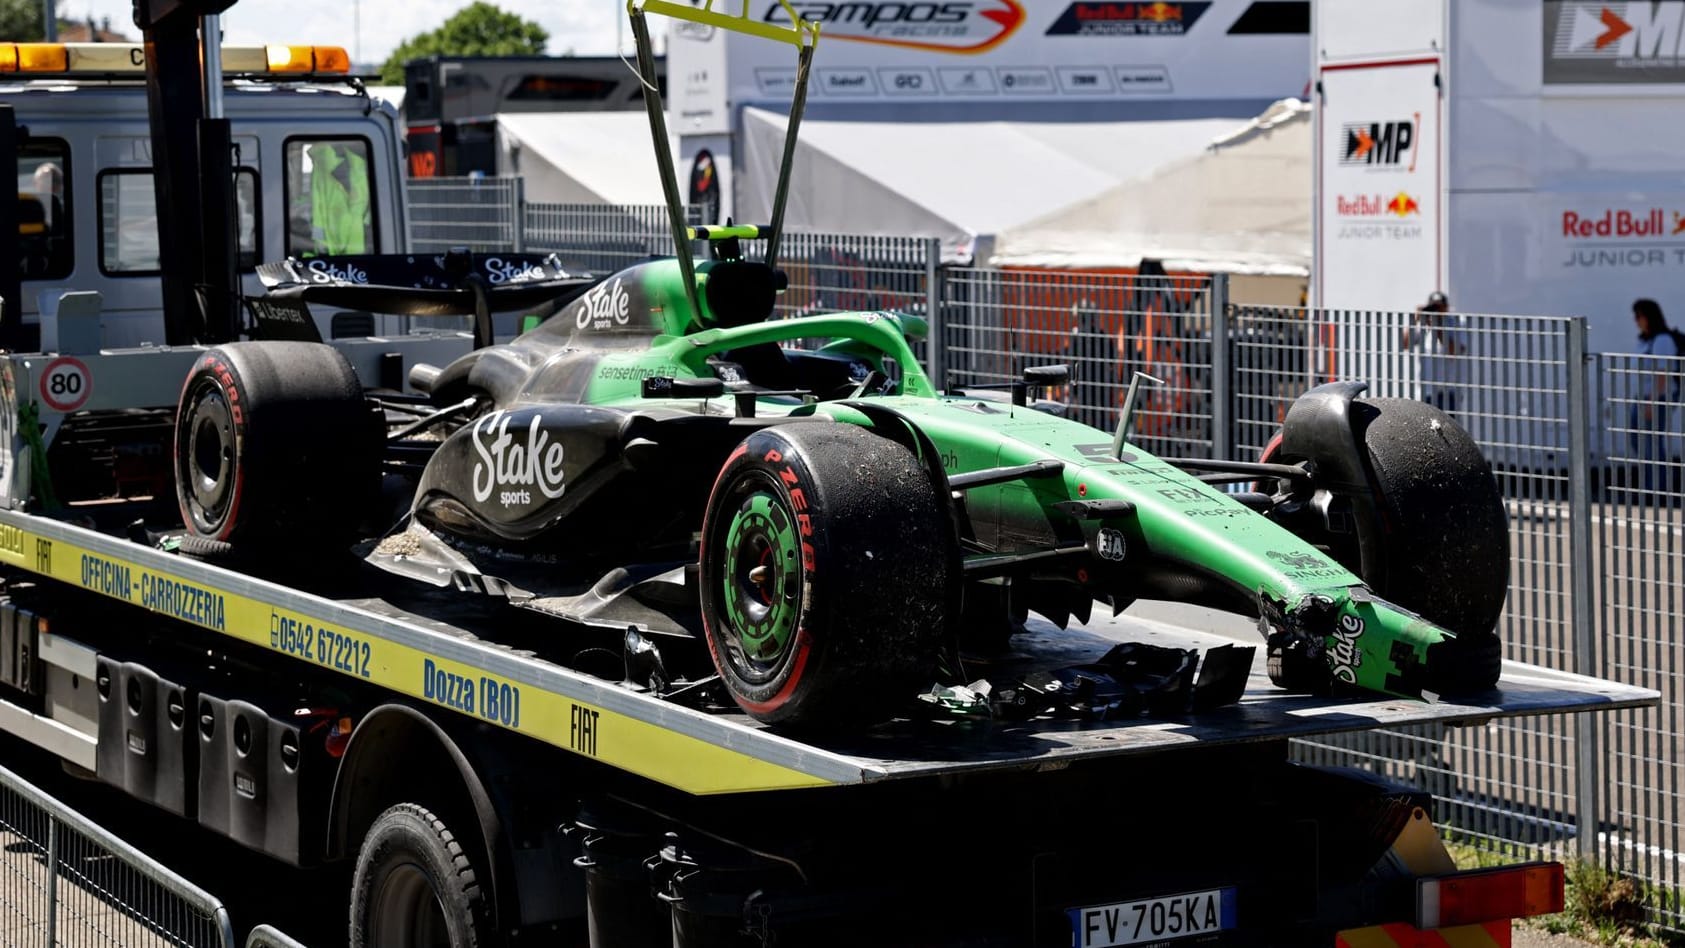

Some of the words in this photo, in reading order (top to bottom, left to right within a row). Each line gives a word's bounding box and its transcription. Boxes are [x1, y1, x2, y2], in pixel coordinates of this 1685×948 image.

[1337, 194, 1360, 215] Red
[1361, 194, 1382, 215] Bull
[1563, 209, 1612, 237] Red
[1616, 208, 1664, 236] Bull
[484, 257, 546, 284] Stake
[1562, 248, 1665, 267] JUNIOR
[309, 260, 368, 284] Stake
[576, 277, 630, 330] Stake
[51, 373, 82, 395] 80
[598, 365, 655, 381] sensetime
[472, 409, 565, 502] Stake
[1073, 443, 1139, 464] 5
[500, 490, 531, 508] sports
[779, 466, 817, 573] ZERO
[36, 538, 52, 575] FIAT
[280, 617, 313, 659] 0542
[318, 628, 371, 678] 672212
[423, 658, 475, 713] Dozza
[571, 704, 600, 757] FIAT
[1326, 613, 1364, 684] Stake
[1085, 908, 1120, 946] FV
[1132, 894, 1218, 940] 705KA
